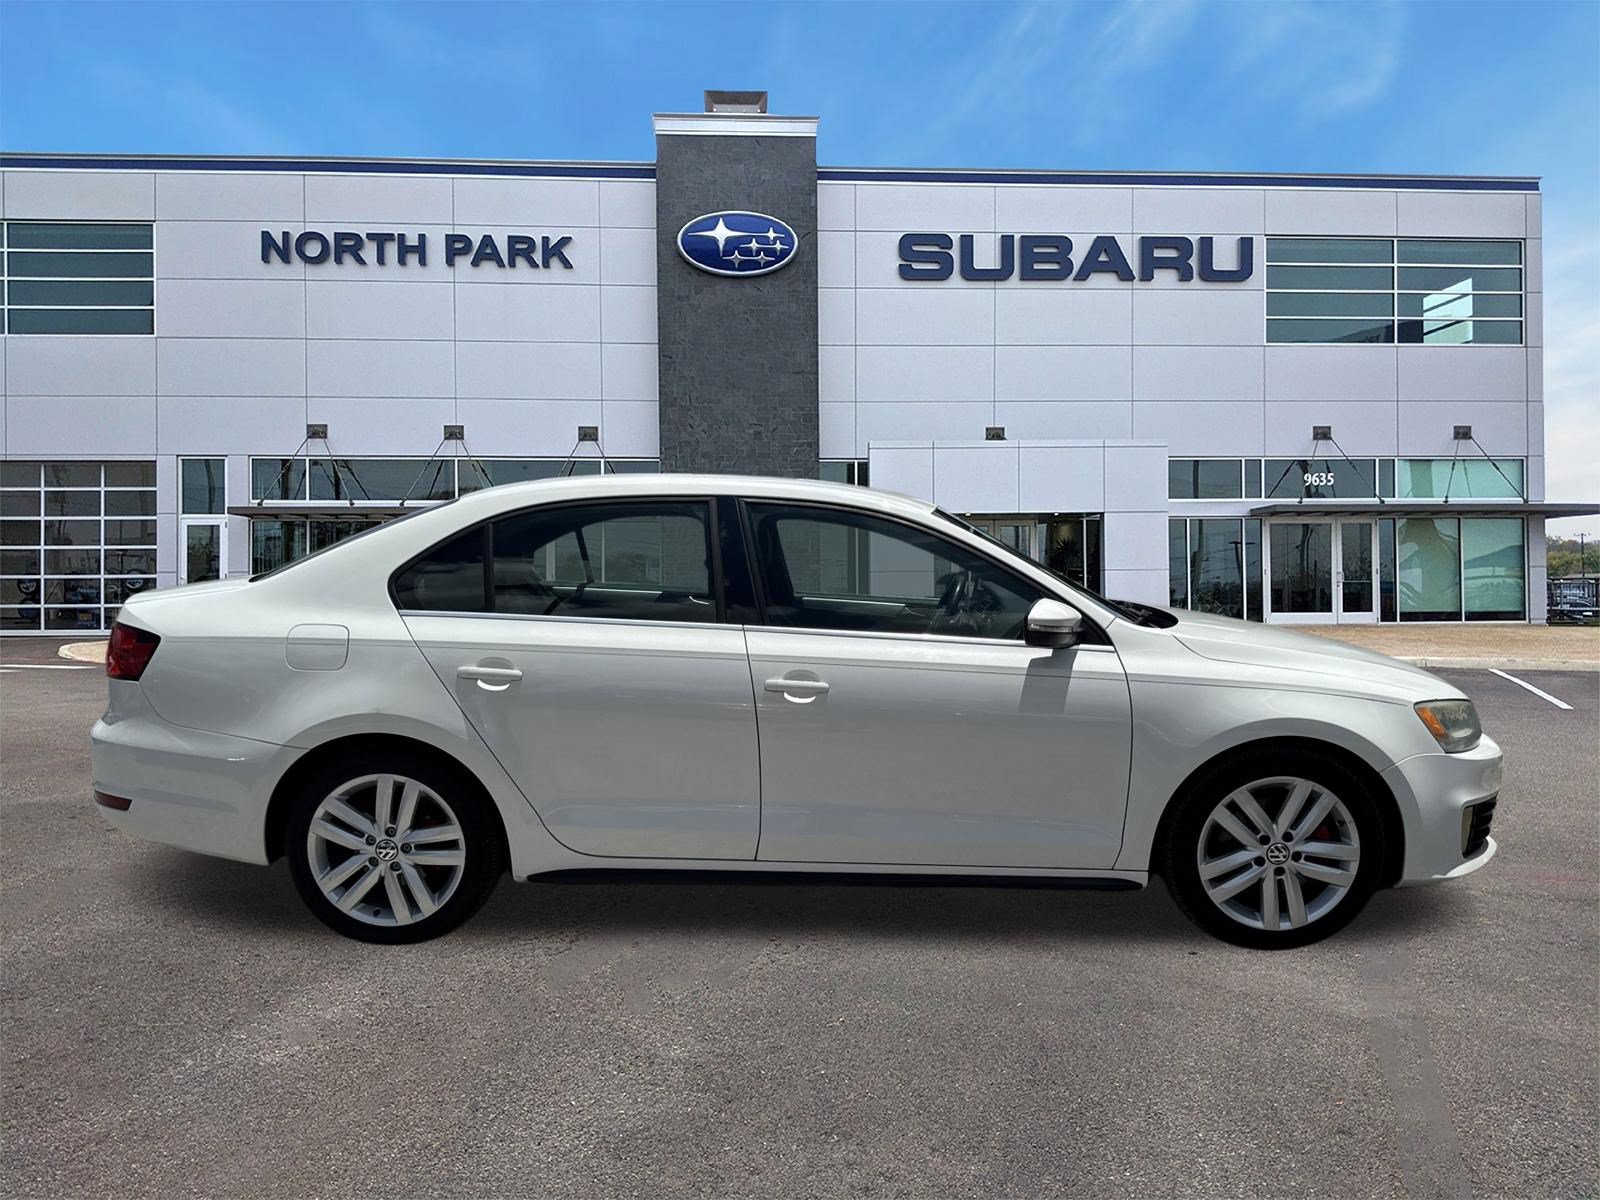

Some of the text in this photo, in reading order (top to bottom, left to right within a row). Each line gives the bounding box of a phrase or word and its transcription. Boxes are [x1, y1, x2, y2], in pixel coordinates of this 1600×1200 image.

[260, 229, 574, 270] NORTH PARK
[897, 232, 1254, 283] SUBARU
[1303, 472, 1335, 487] 9635
